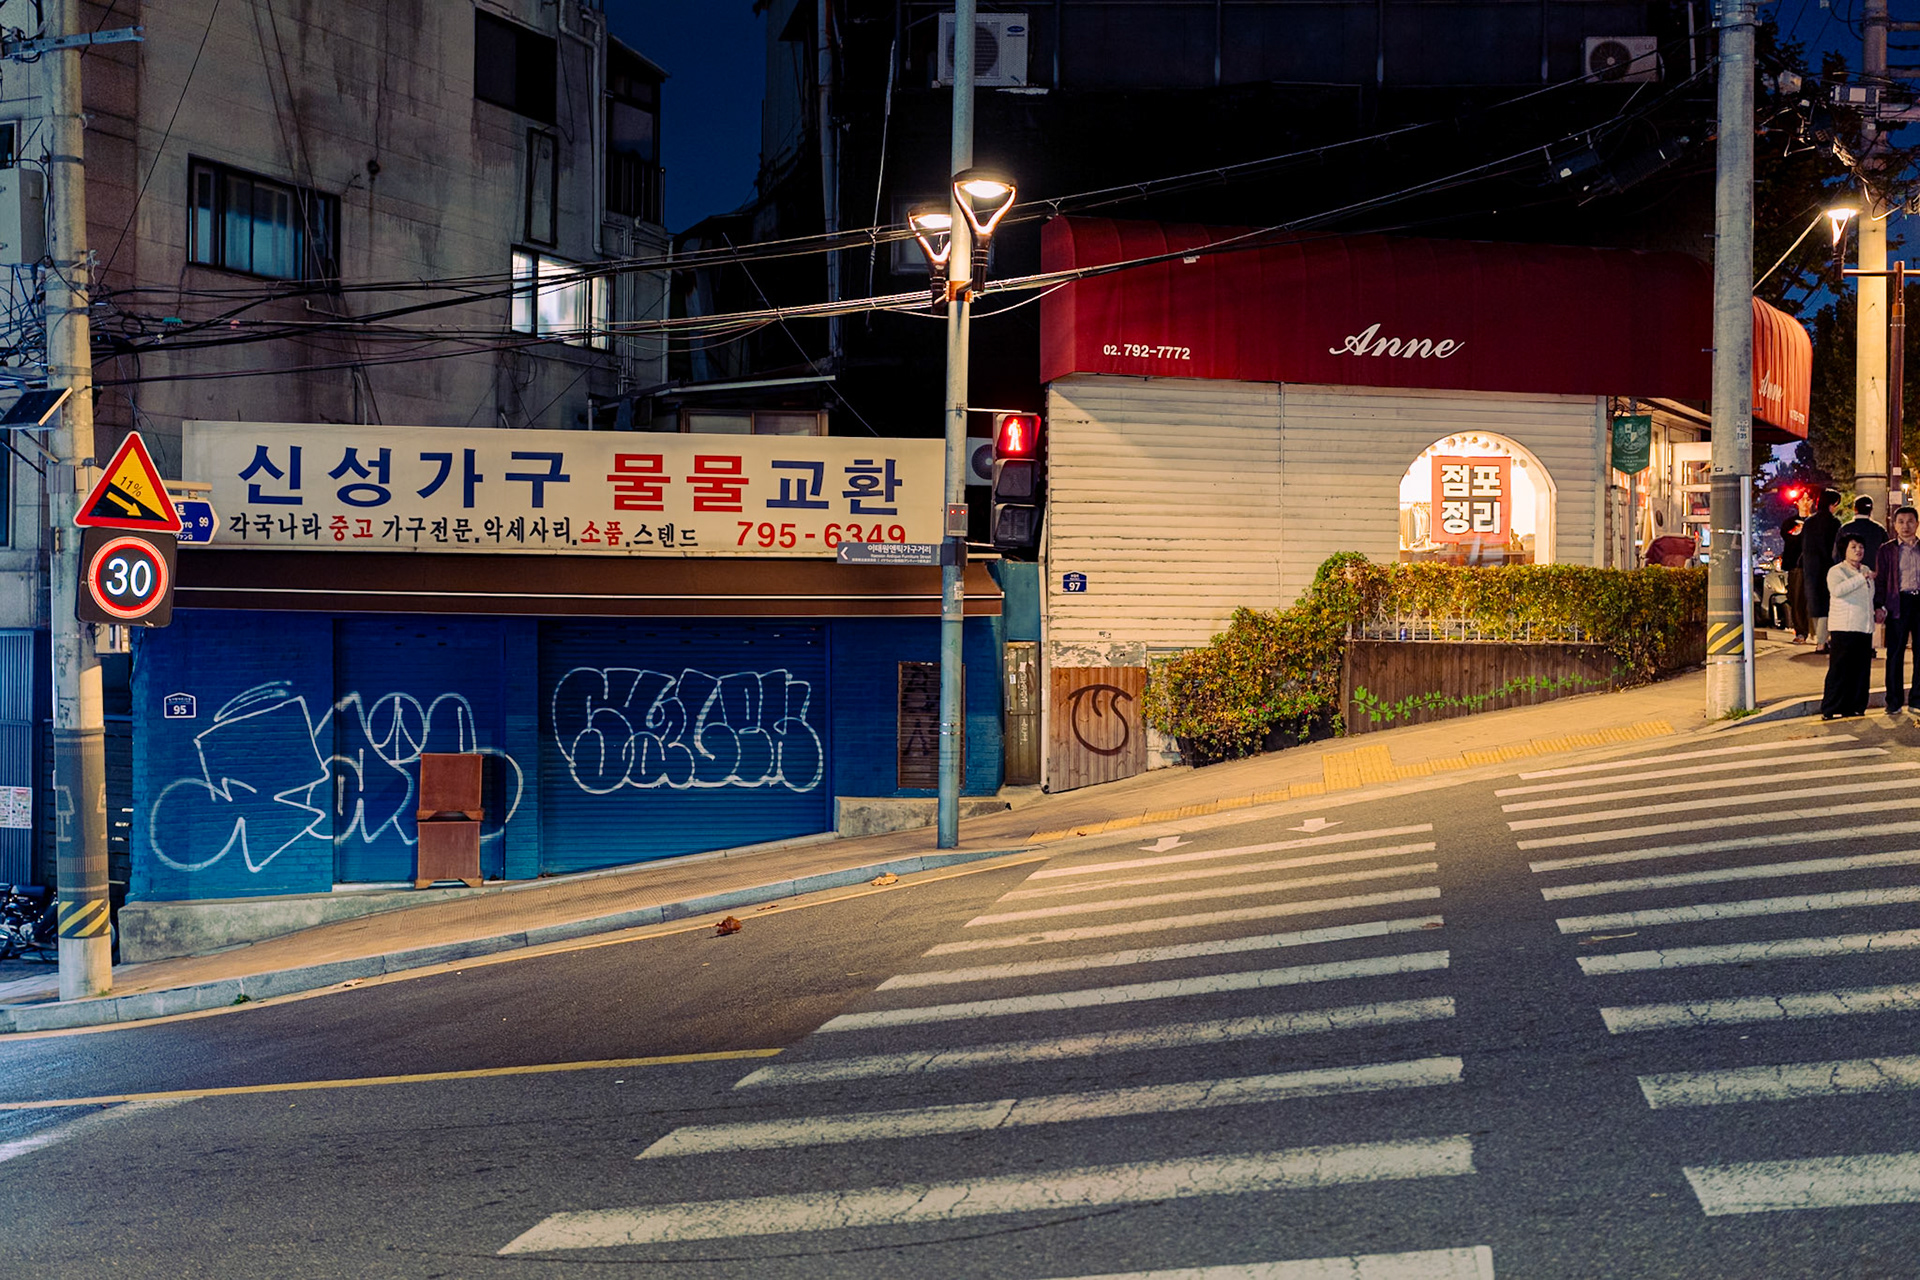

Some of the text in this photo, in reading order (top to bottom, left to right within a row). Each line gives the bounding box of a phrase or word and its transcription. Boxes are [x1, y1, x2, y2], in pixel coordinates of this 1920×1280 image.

[1328, 323, 1466, 359] Anne
[120, 476, 143, 497] 11%
[238, 444, 903, 515] 신성가구 물물교환
[1441, 464, 1502, 497] 점포
[199, 516, 209, 527] 99
[229, 512, 322, 541] 각국나라
[328, 515, 374, 542] 중고
[1441, 501, 1501, 534] 정리
[736, 521, 906, 548] 795-6349
[105, 558, 151, 597] 30
[1069, 582, 1081, 591] 97
[173, 705, 187, 715] 95
